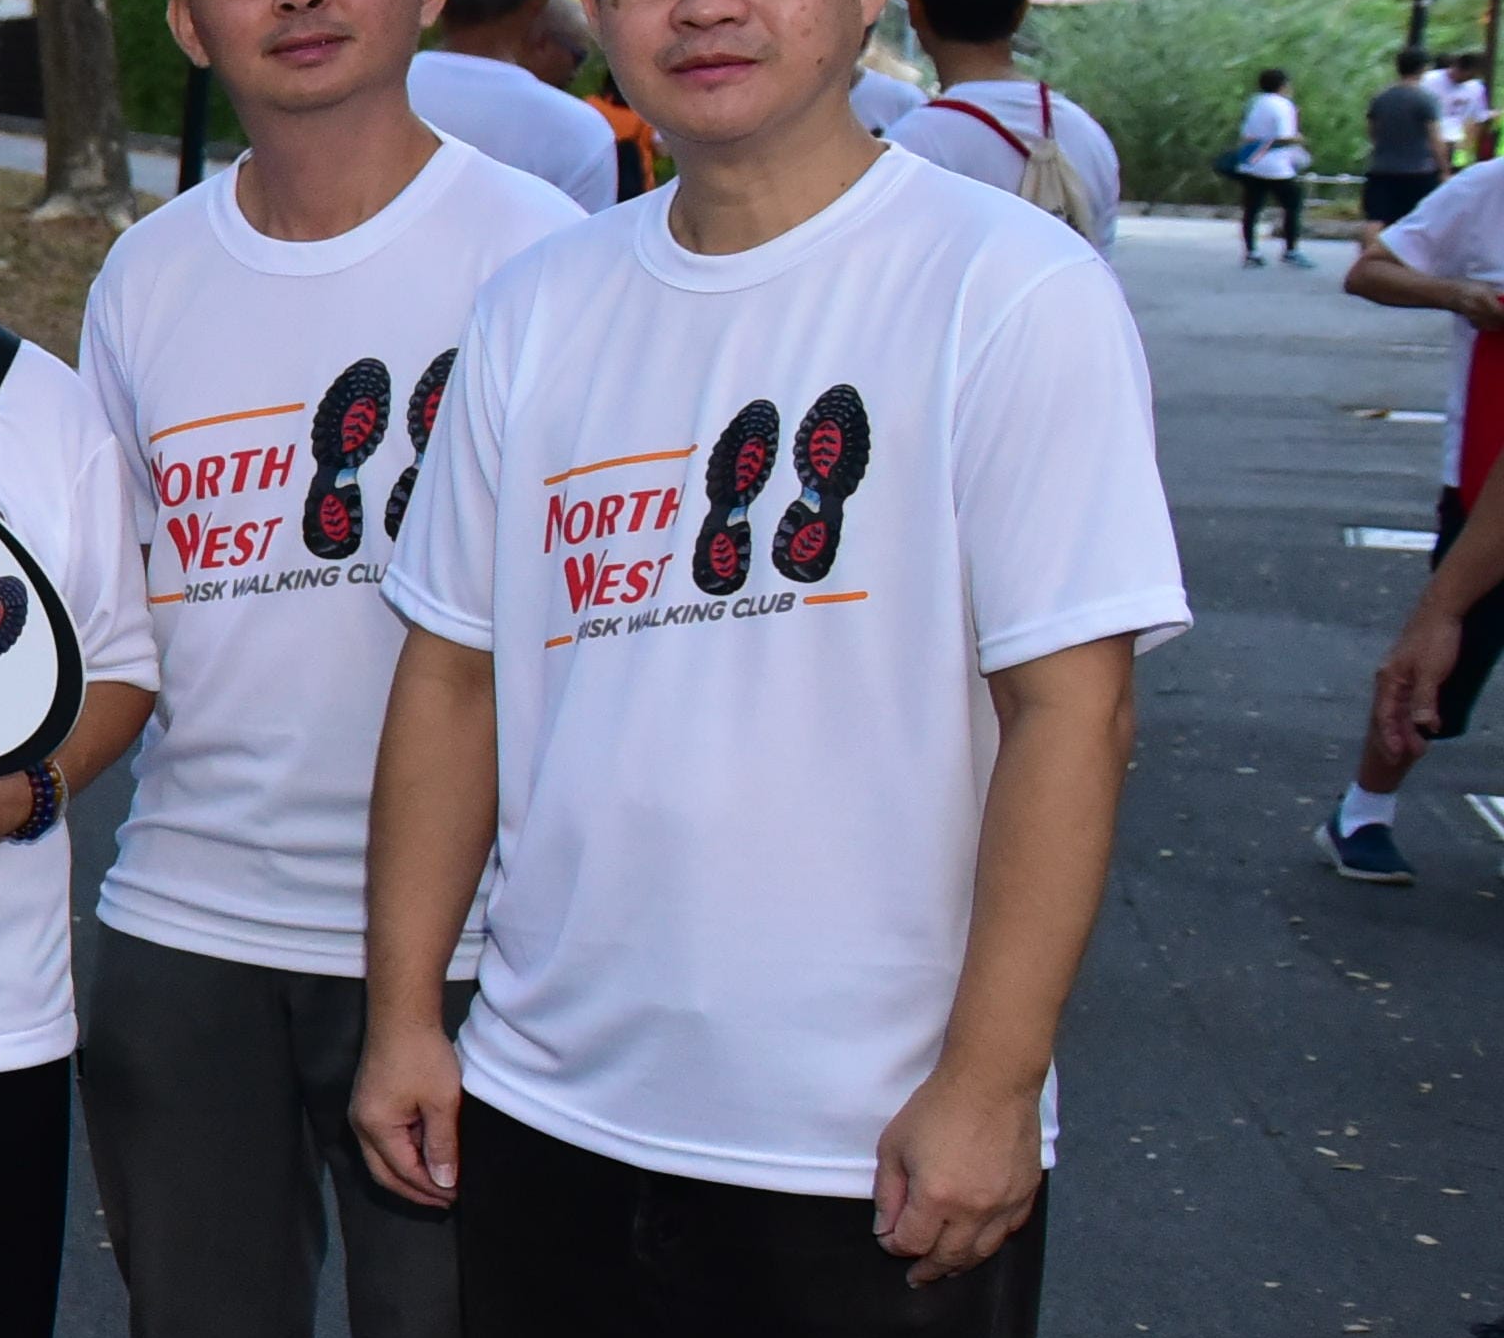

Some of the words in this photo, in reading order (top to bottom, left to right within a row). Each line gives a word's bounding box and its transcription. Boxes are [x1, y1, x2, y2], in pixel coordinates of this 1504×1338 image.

[166, 511, 283, 574] WEST
[232, 565, 342, 599] WALKING
[347, 562, 388, 584] CLU
[564, 549, 674, 614] WEST
[627, 600, 727, 635] WALKING
[732, 592, 796, 619] CLUB
